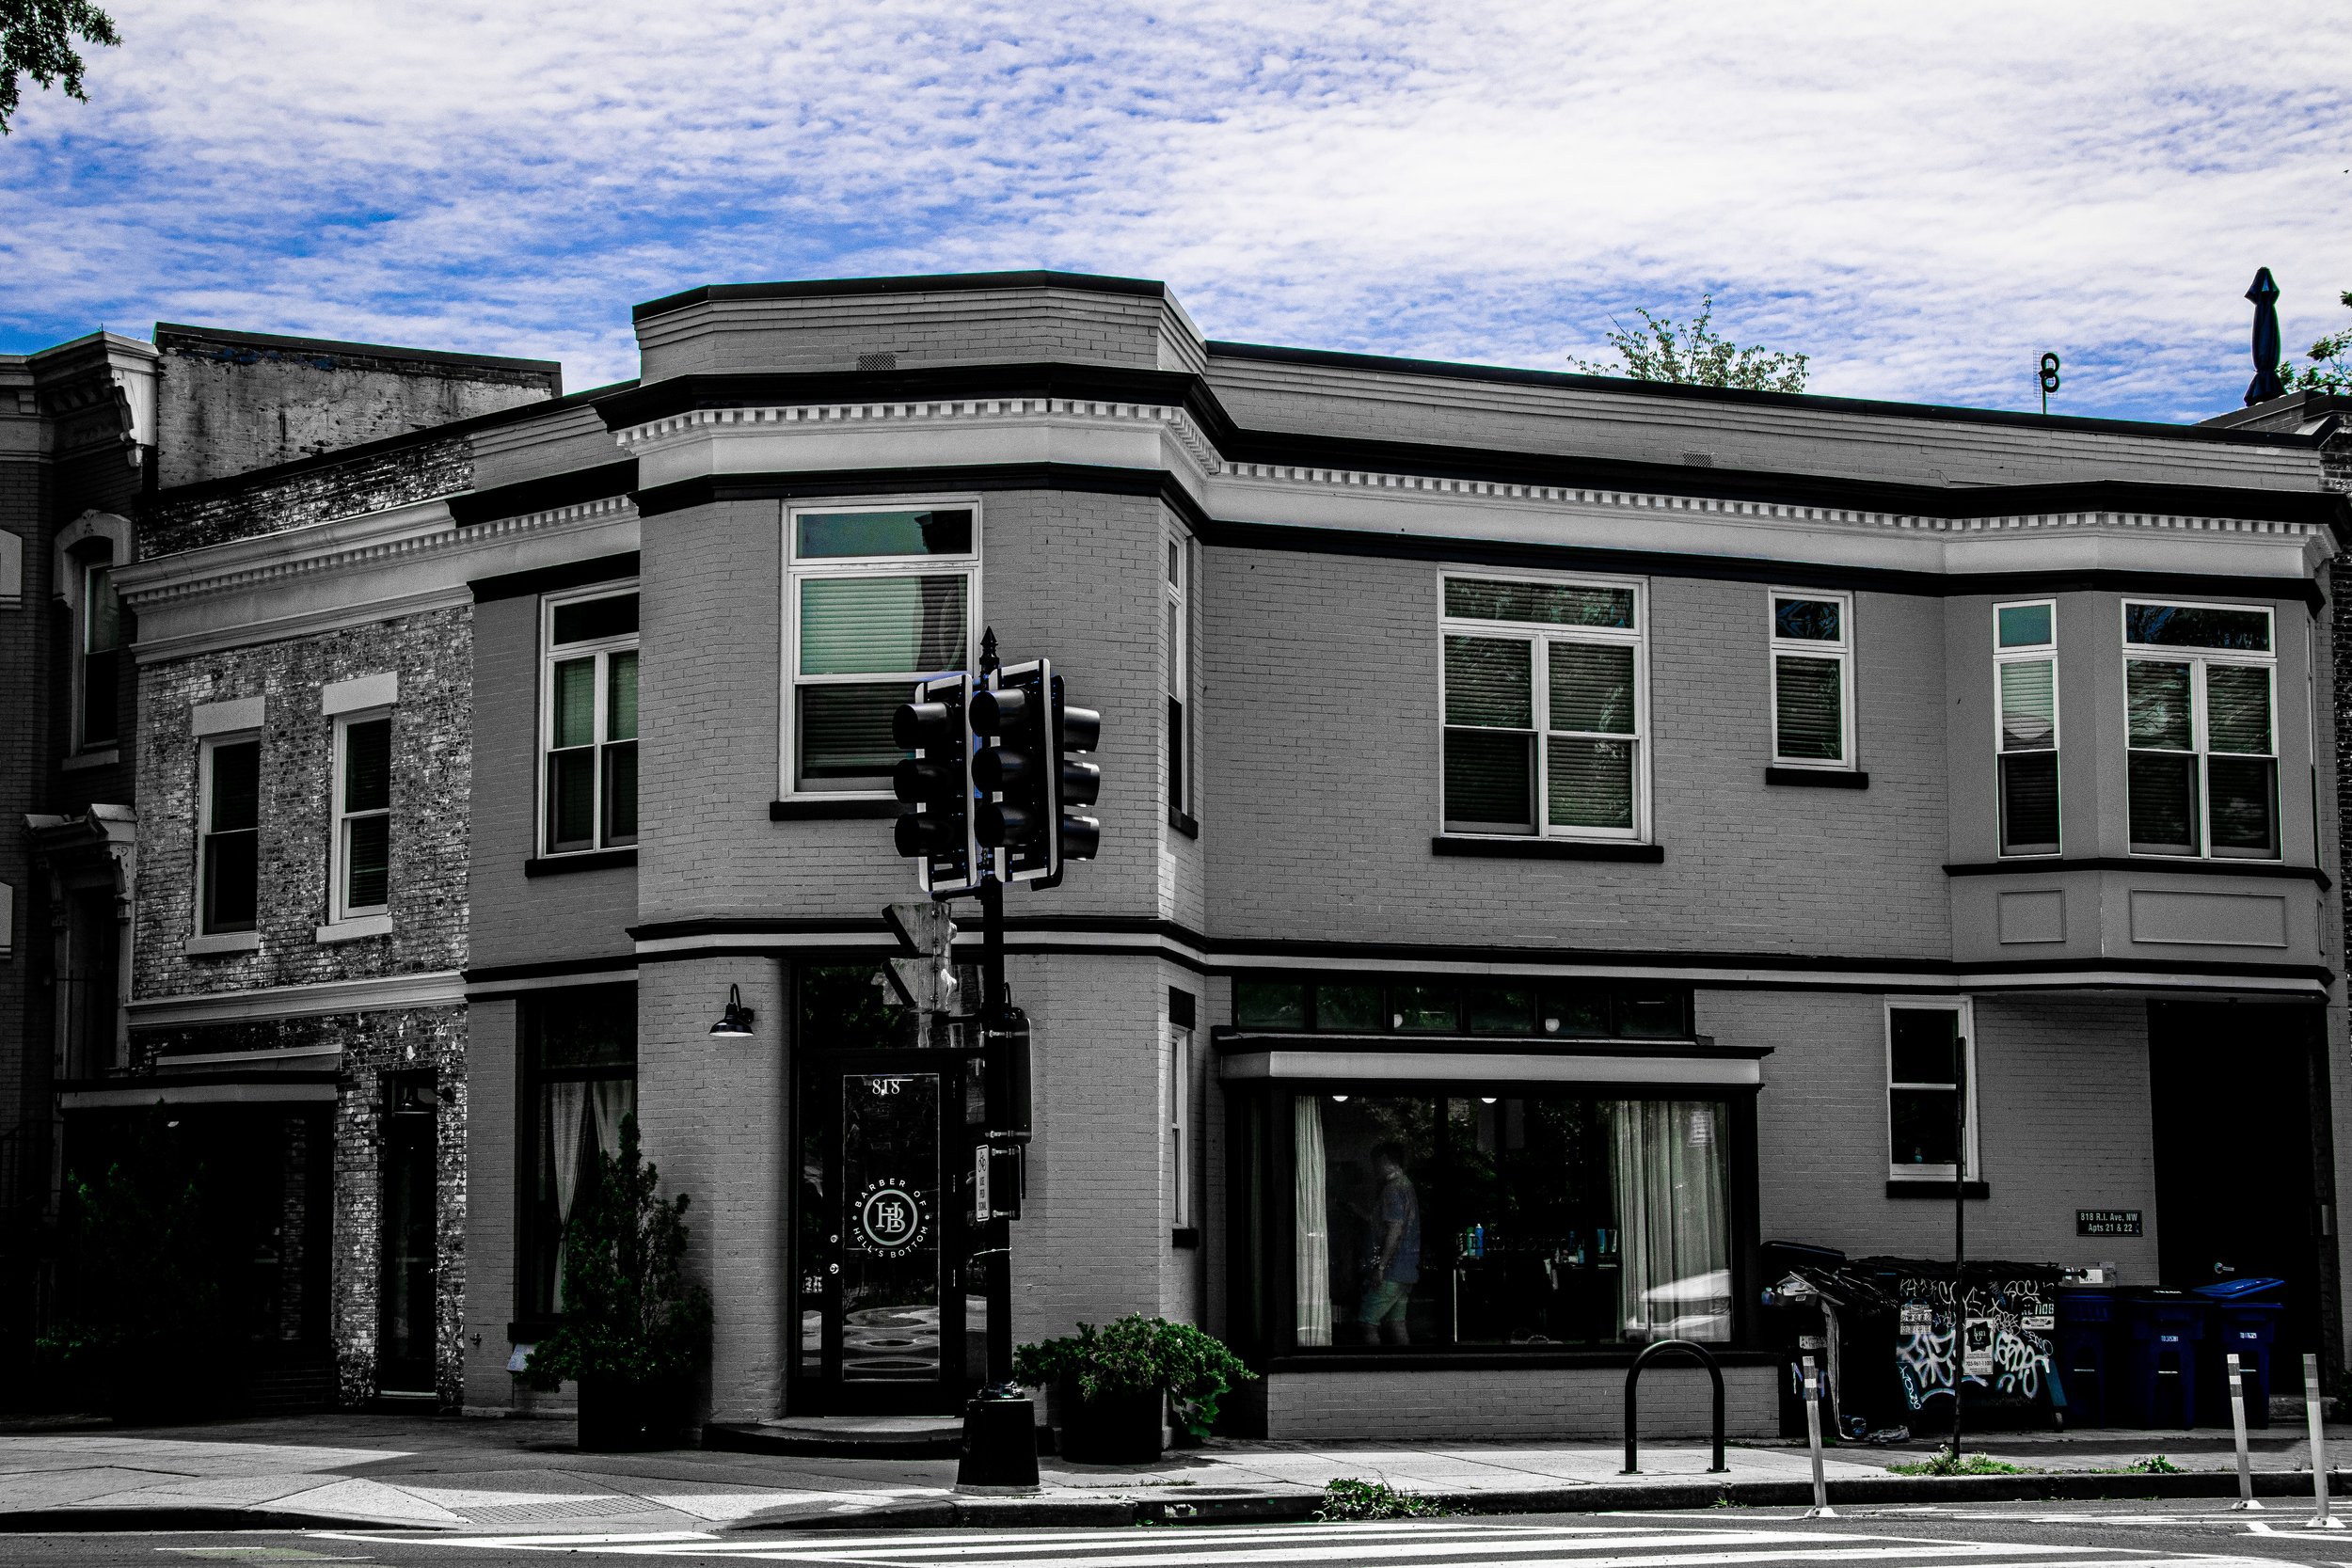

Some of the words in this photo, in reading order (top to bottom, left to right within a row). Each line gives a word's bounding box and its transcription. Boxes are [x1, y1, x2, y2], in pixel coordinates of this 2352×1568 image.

[872, 1079, 900, 1095] 818
[854, 1178, 906, 1208] BARBER
[914, 1190, 927, 1207] OF
[2080, 1212, 2094, 1221] 818
[2095, 1212, 2108, 1221] R.I.
[2125, 1212, 2138, 1222] NW
[2088, 1223, 2104, 1233] Apts
[2105, 1223, 2114, 1232] 21
[2116, 1224, 2122, 1232] &
[2123, 1224, 2133, 1232] 22
[853, 1227, 884, 1258] HELL'S
[890, 1226, 929, 1259] BOTTOM
